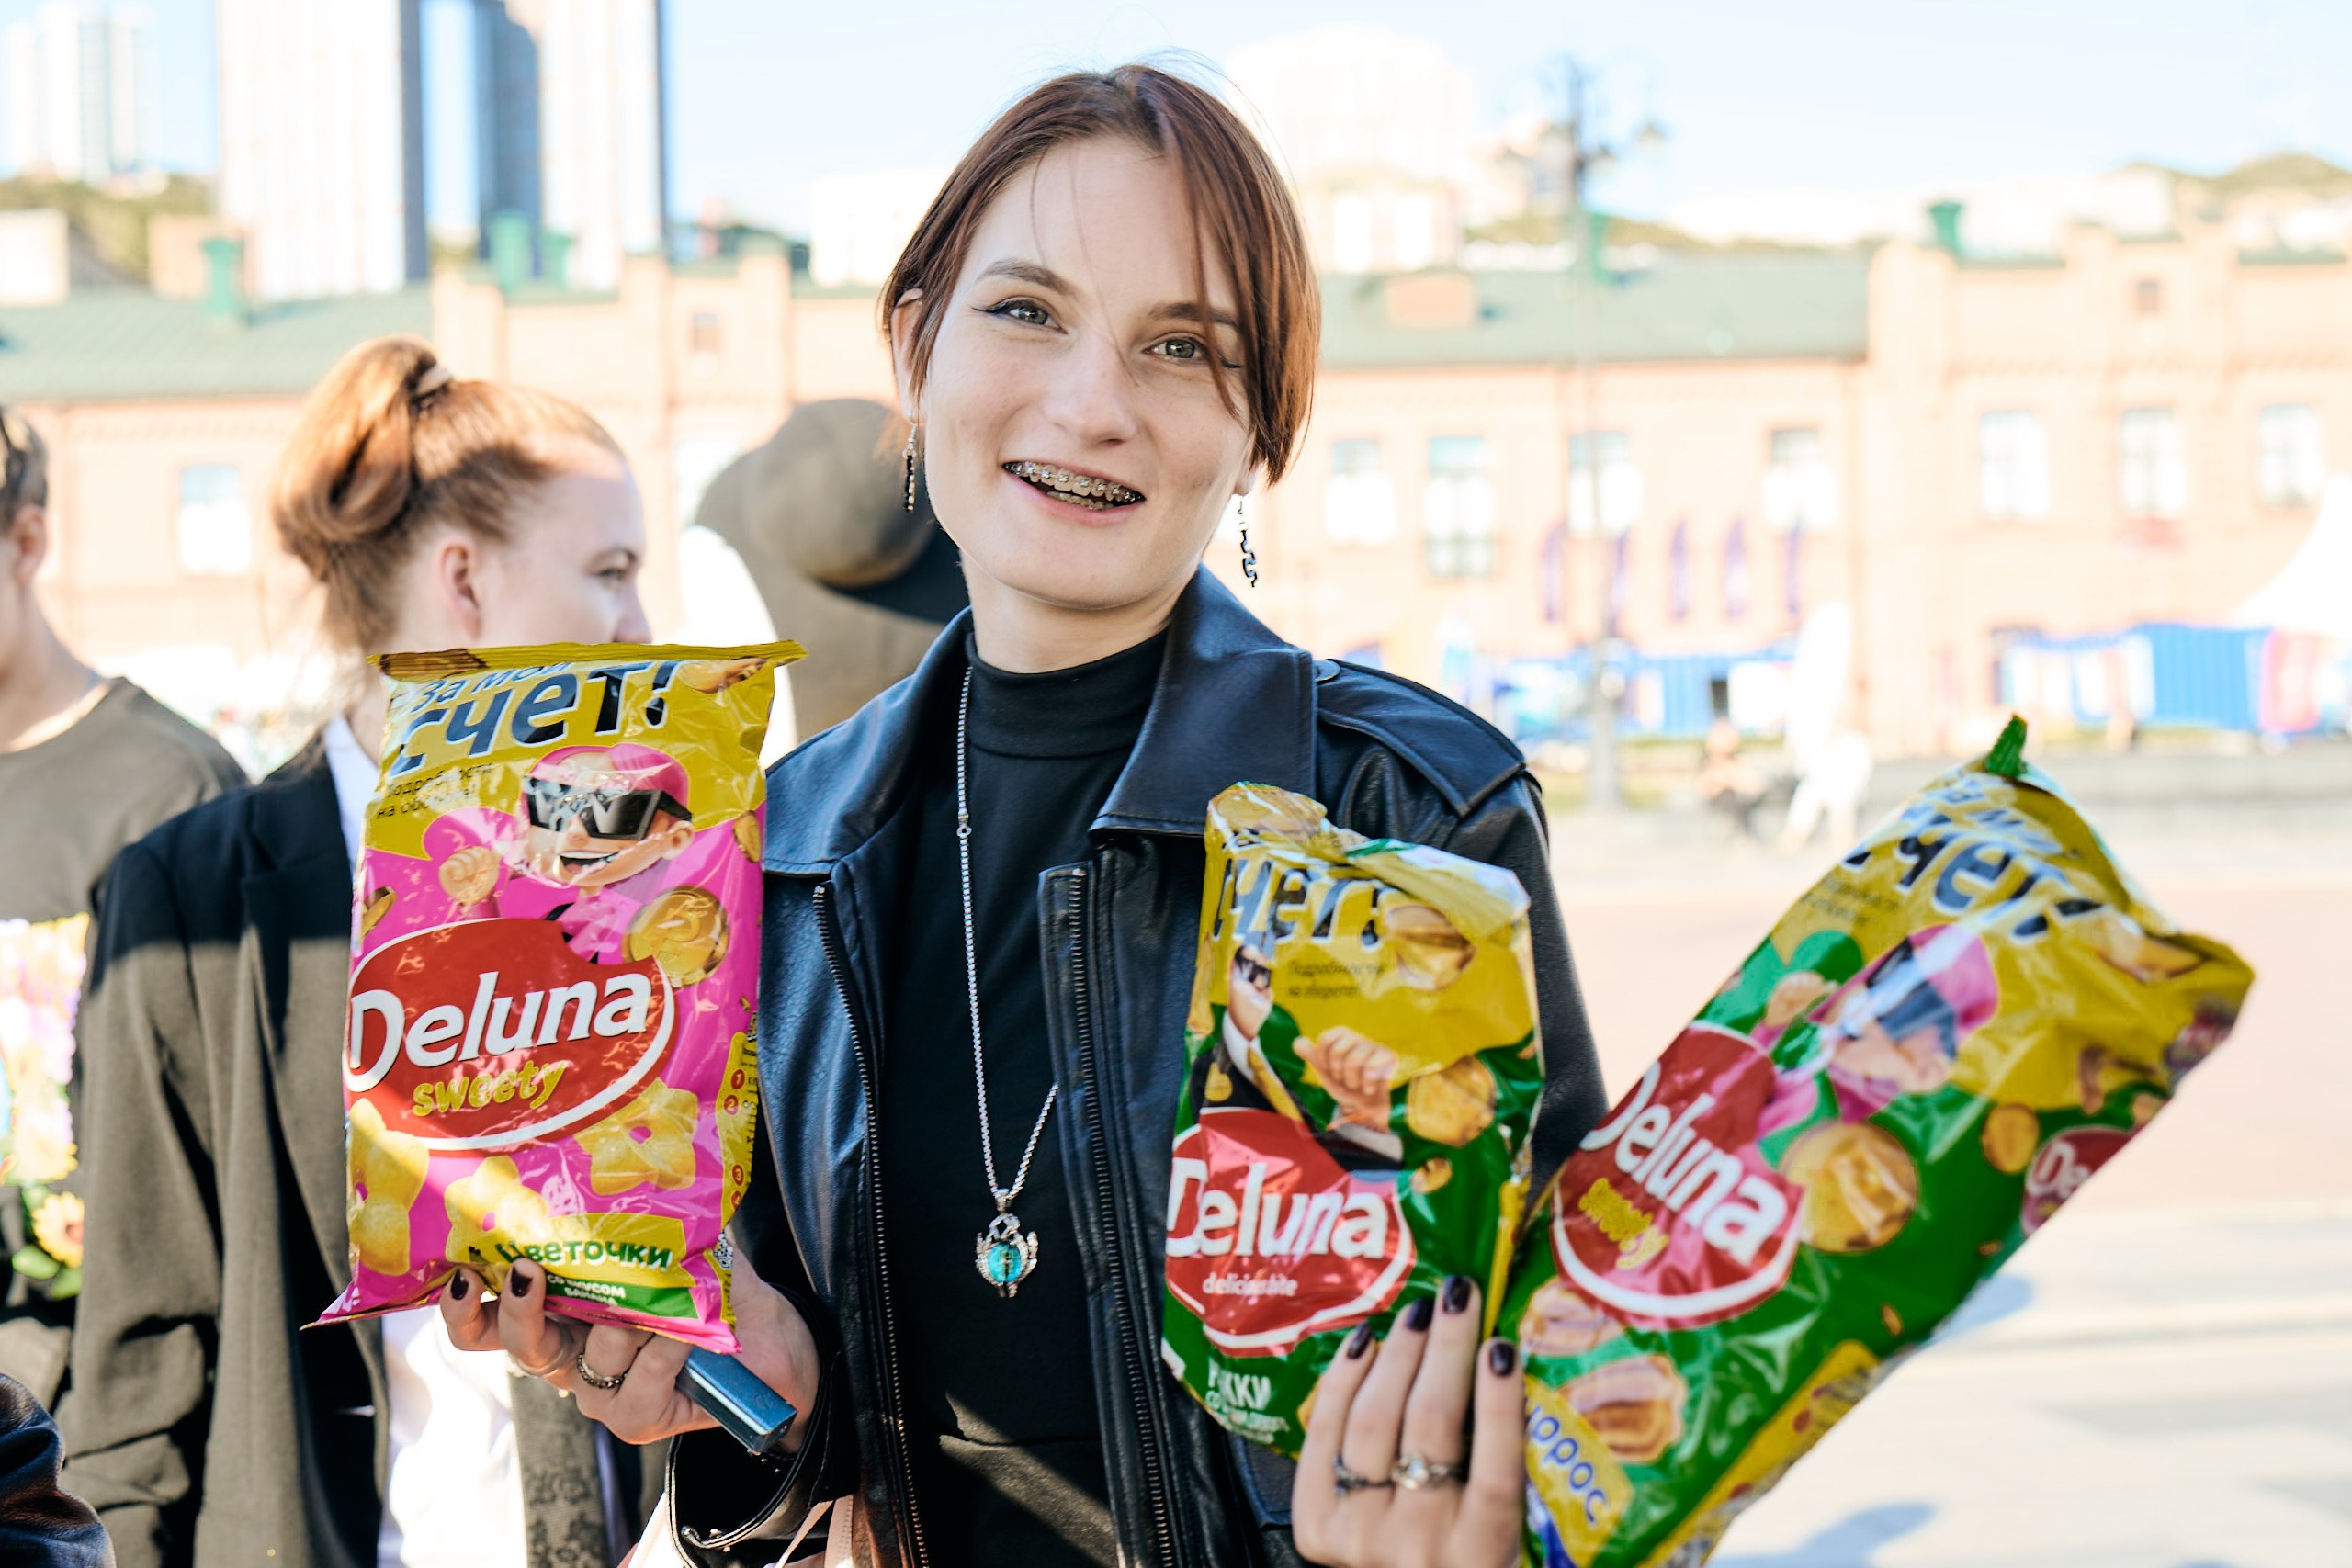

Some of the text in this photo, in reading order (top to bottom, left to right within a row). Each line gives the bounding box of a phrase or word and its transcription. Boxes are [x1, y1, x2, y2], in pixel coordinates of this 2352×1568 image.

[410, 679, 469, 714] За
[345, 971, 652, 1093] Deluna
[412, 1058, 570, 1118] sweety
[494, 1240, 673, 1272] Цветочки
